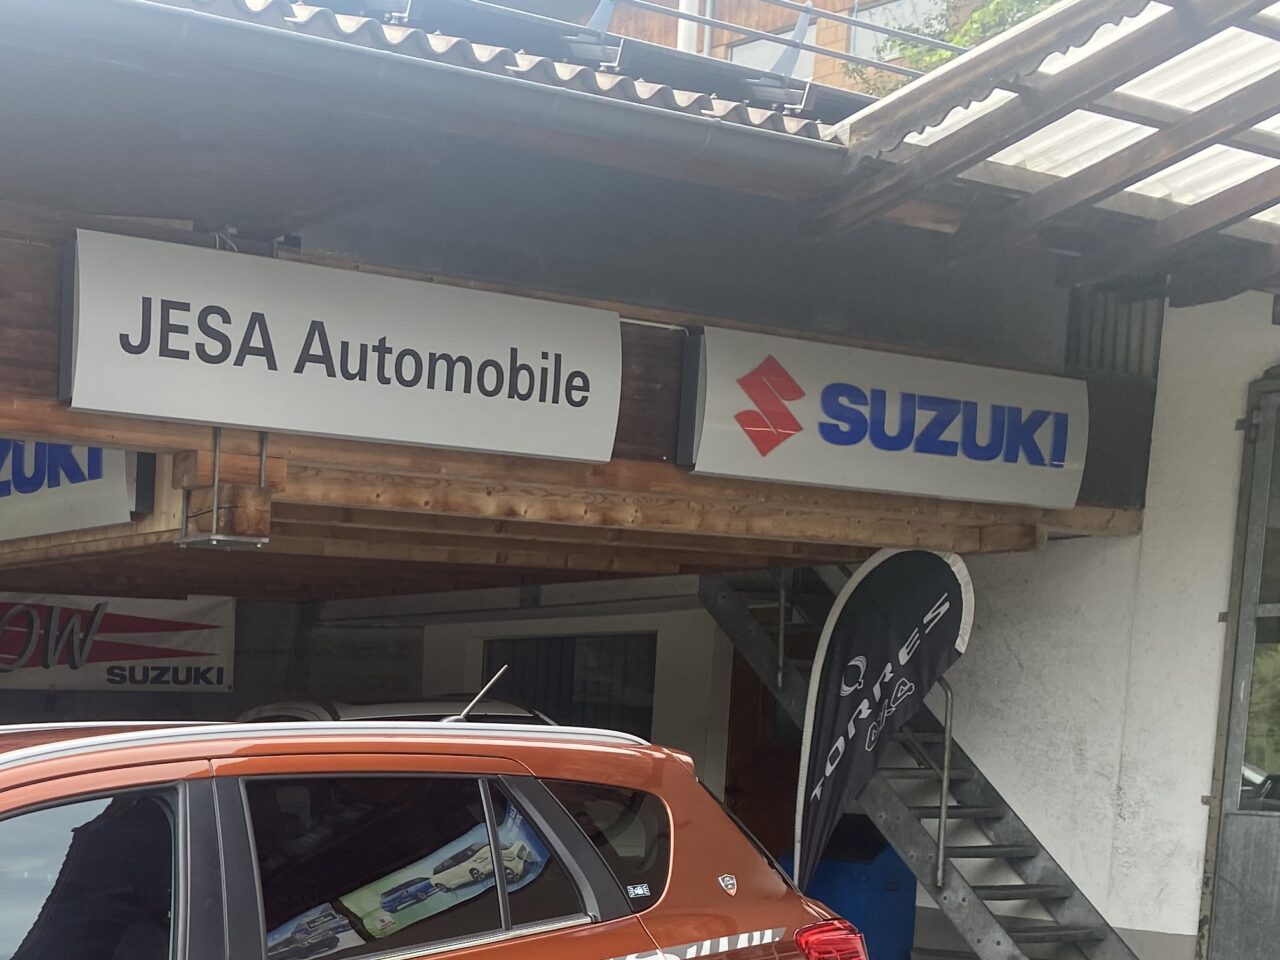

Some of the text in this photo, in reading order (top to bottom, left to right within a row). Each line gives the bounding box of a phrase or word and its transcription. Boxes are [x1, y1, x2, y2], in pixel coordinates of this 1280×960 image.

[119, 295, 591, 408] JESA Automobile
[818, 382, 1069, 468] SUZUKI
[106, 666, 224, 686] SUZUKI
[810, 592, 951, 800] TORRES
